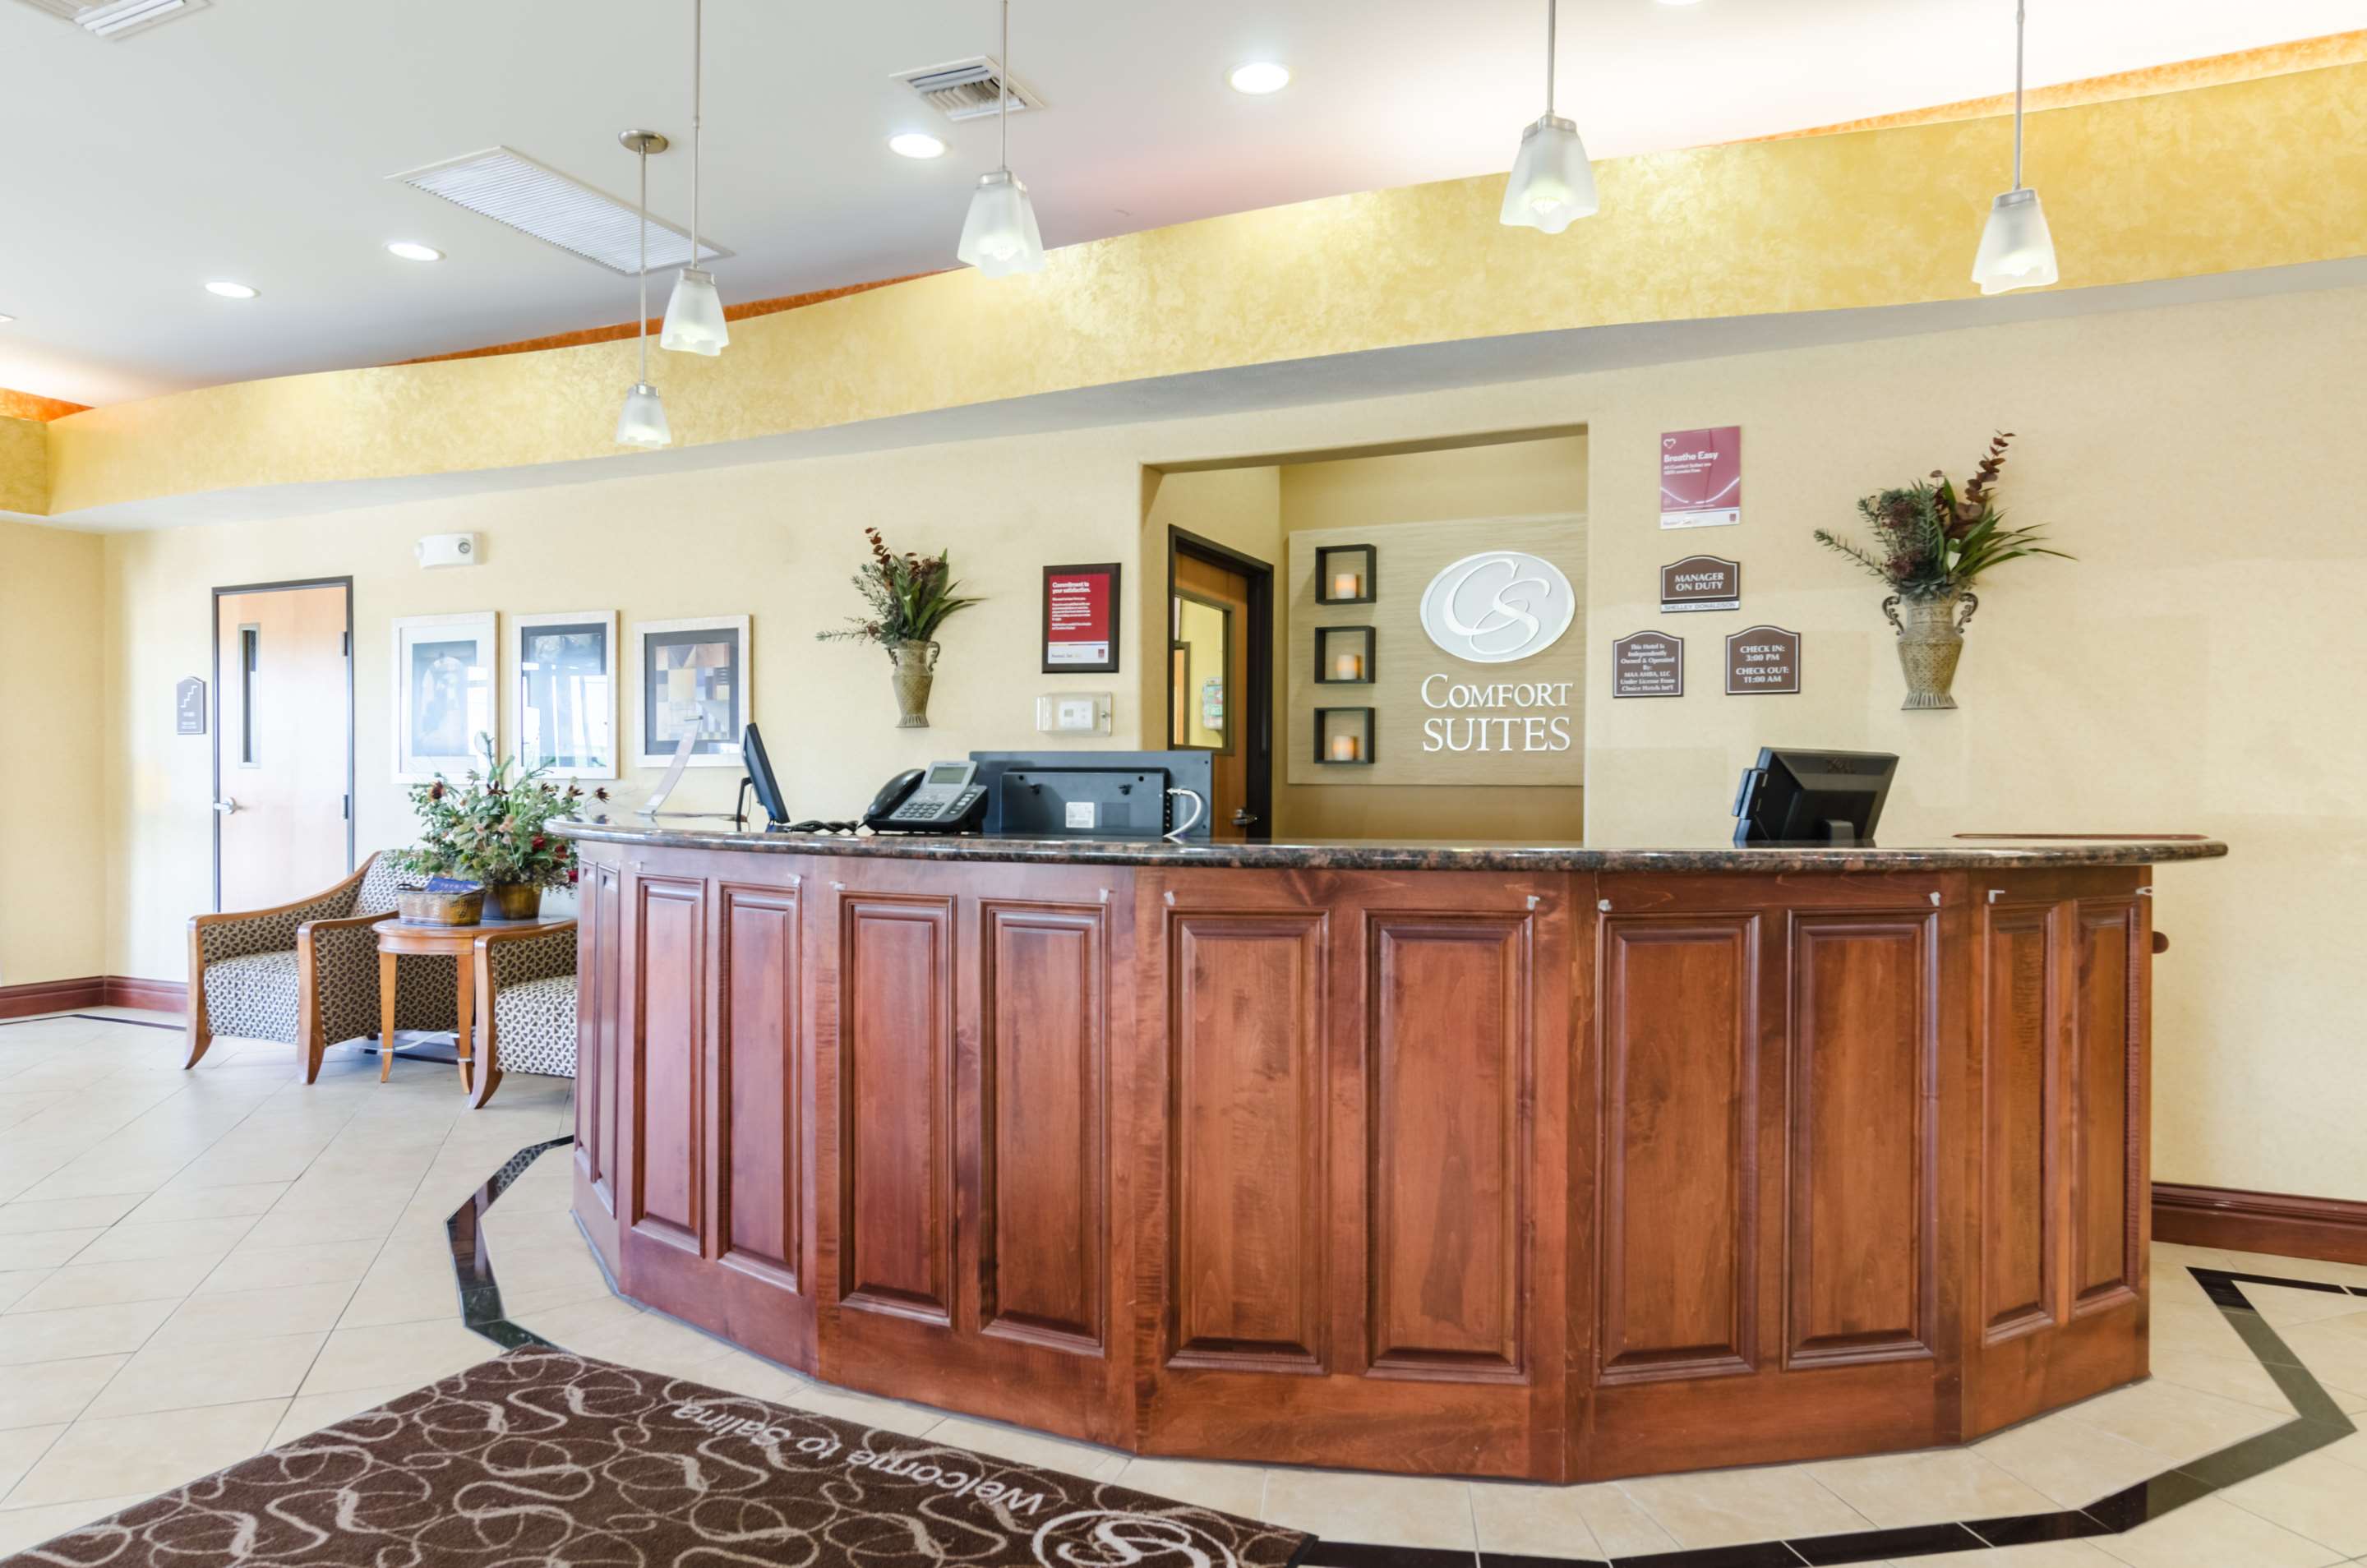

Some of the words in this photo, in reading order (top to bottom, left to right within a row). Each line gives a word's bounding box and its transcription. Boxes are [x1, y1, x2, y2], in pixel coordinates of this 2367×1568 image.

[1663, 453, 1696, 463] Breathe
[1698, 451, 1719, 460] Easy
[1674, 572, 1725, 583] MANAGER
[1676, 582, 1692, 592] ON
[1695, 581, 1723, 590] DUTY
[1627, 650, 1667, 658] Independently
[1740, 645, 1770, 653] CHECK
[1772, 644, 1785, 653] IN:
[1735, 666, 1766, 675] CHECK
[1421, 674, 1573, 708] COMFORT
[1423, 717, 1571, 752] SUITES
[671, 1404, 791, 1446] Salina
[796, 1437, 843, 1460] to
[847, 1450, 1044, 1515] Welcome
